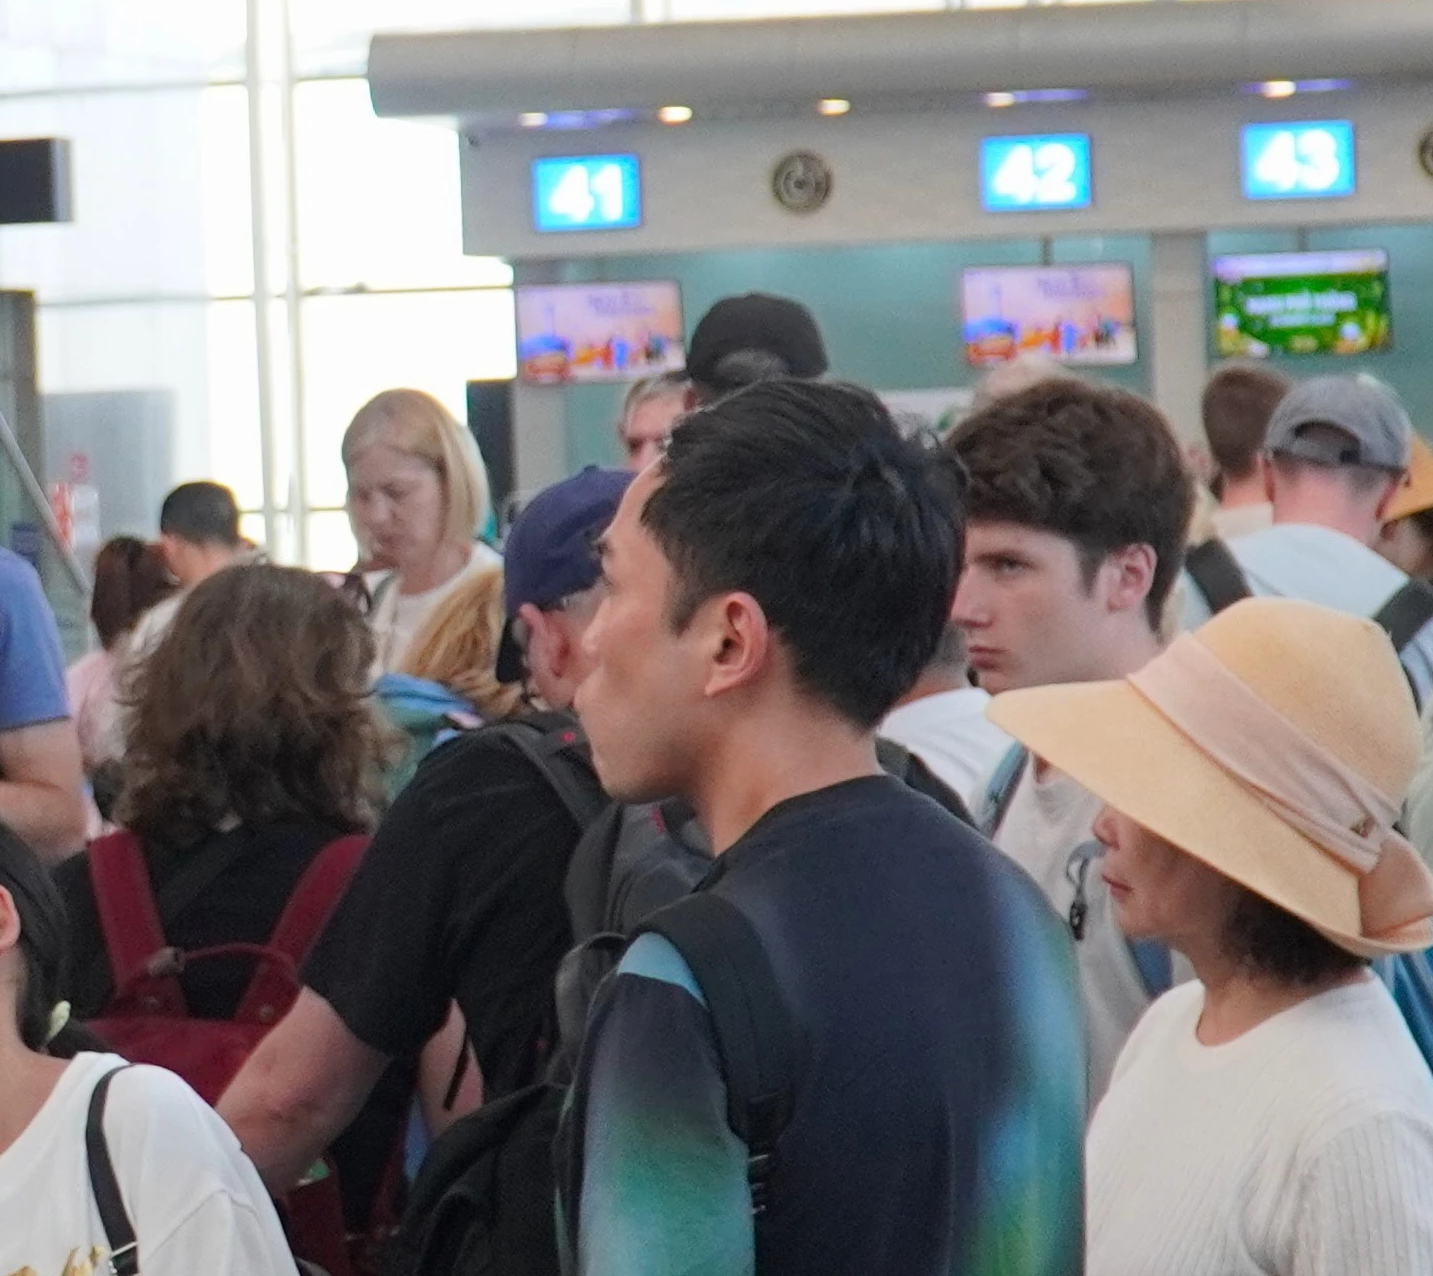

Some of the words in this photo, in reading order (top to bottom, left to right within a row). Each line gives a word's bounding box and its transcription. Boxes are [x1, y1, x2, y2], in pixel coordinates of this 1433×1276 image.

[991, 143, 1078, 203] 42
[1253, 130, 1341, 189] 43
[548, 163, 624, 222] 41
